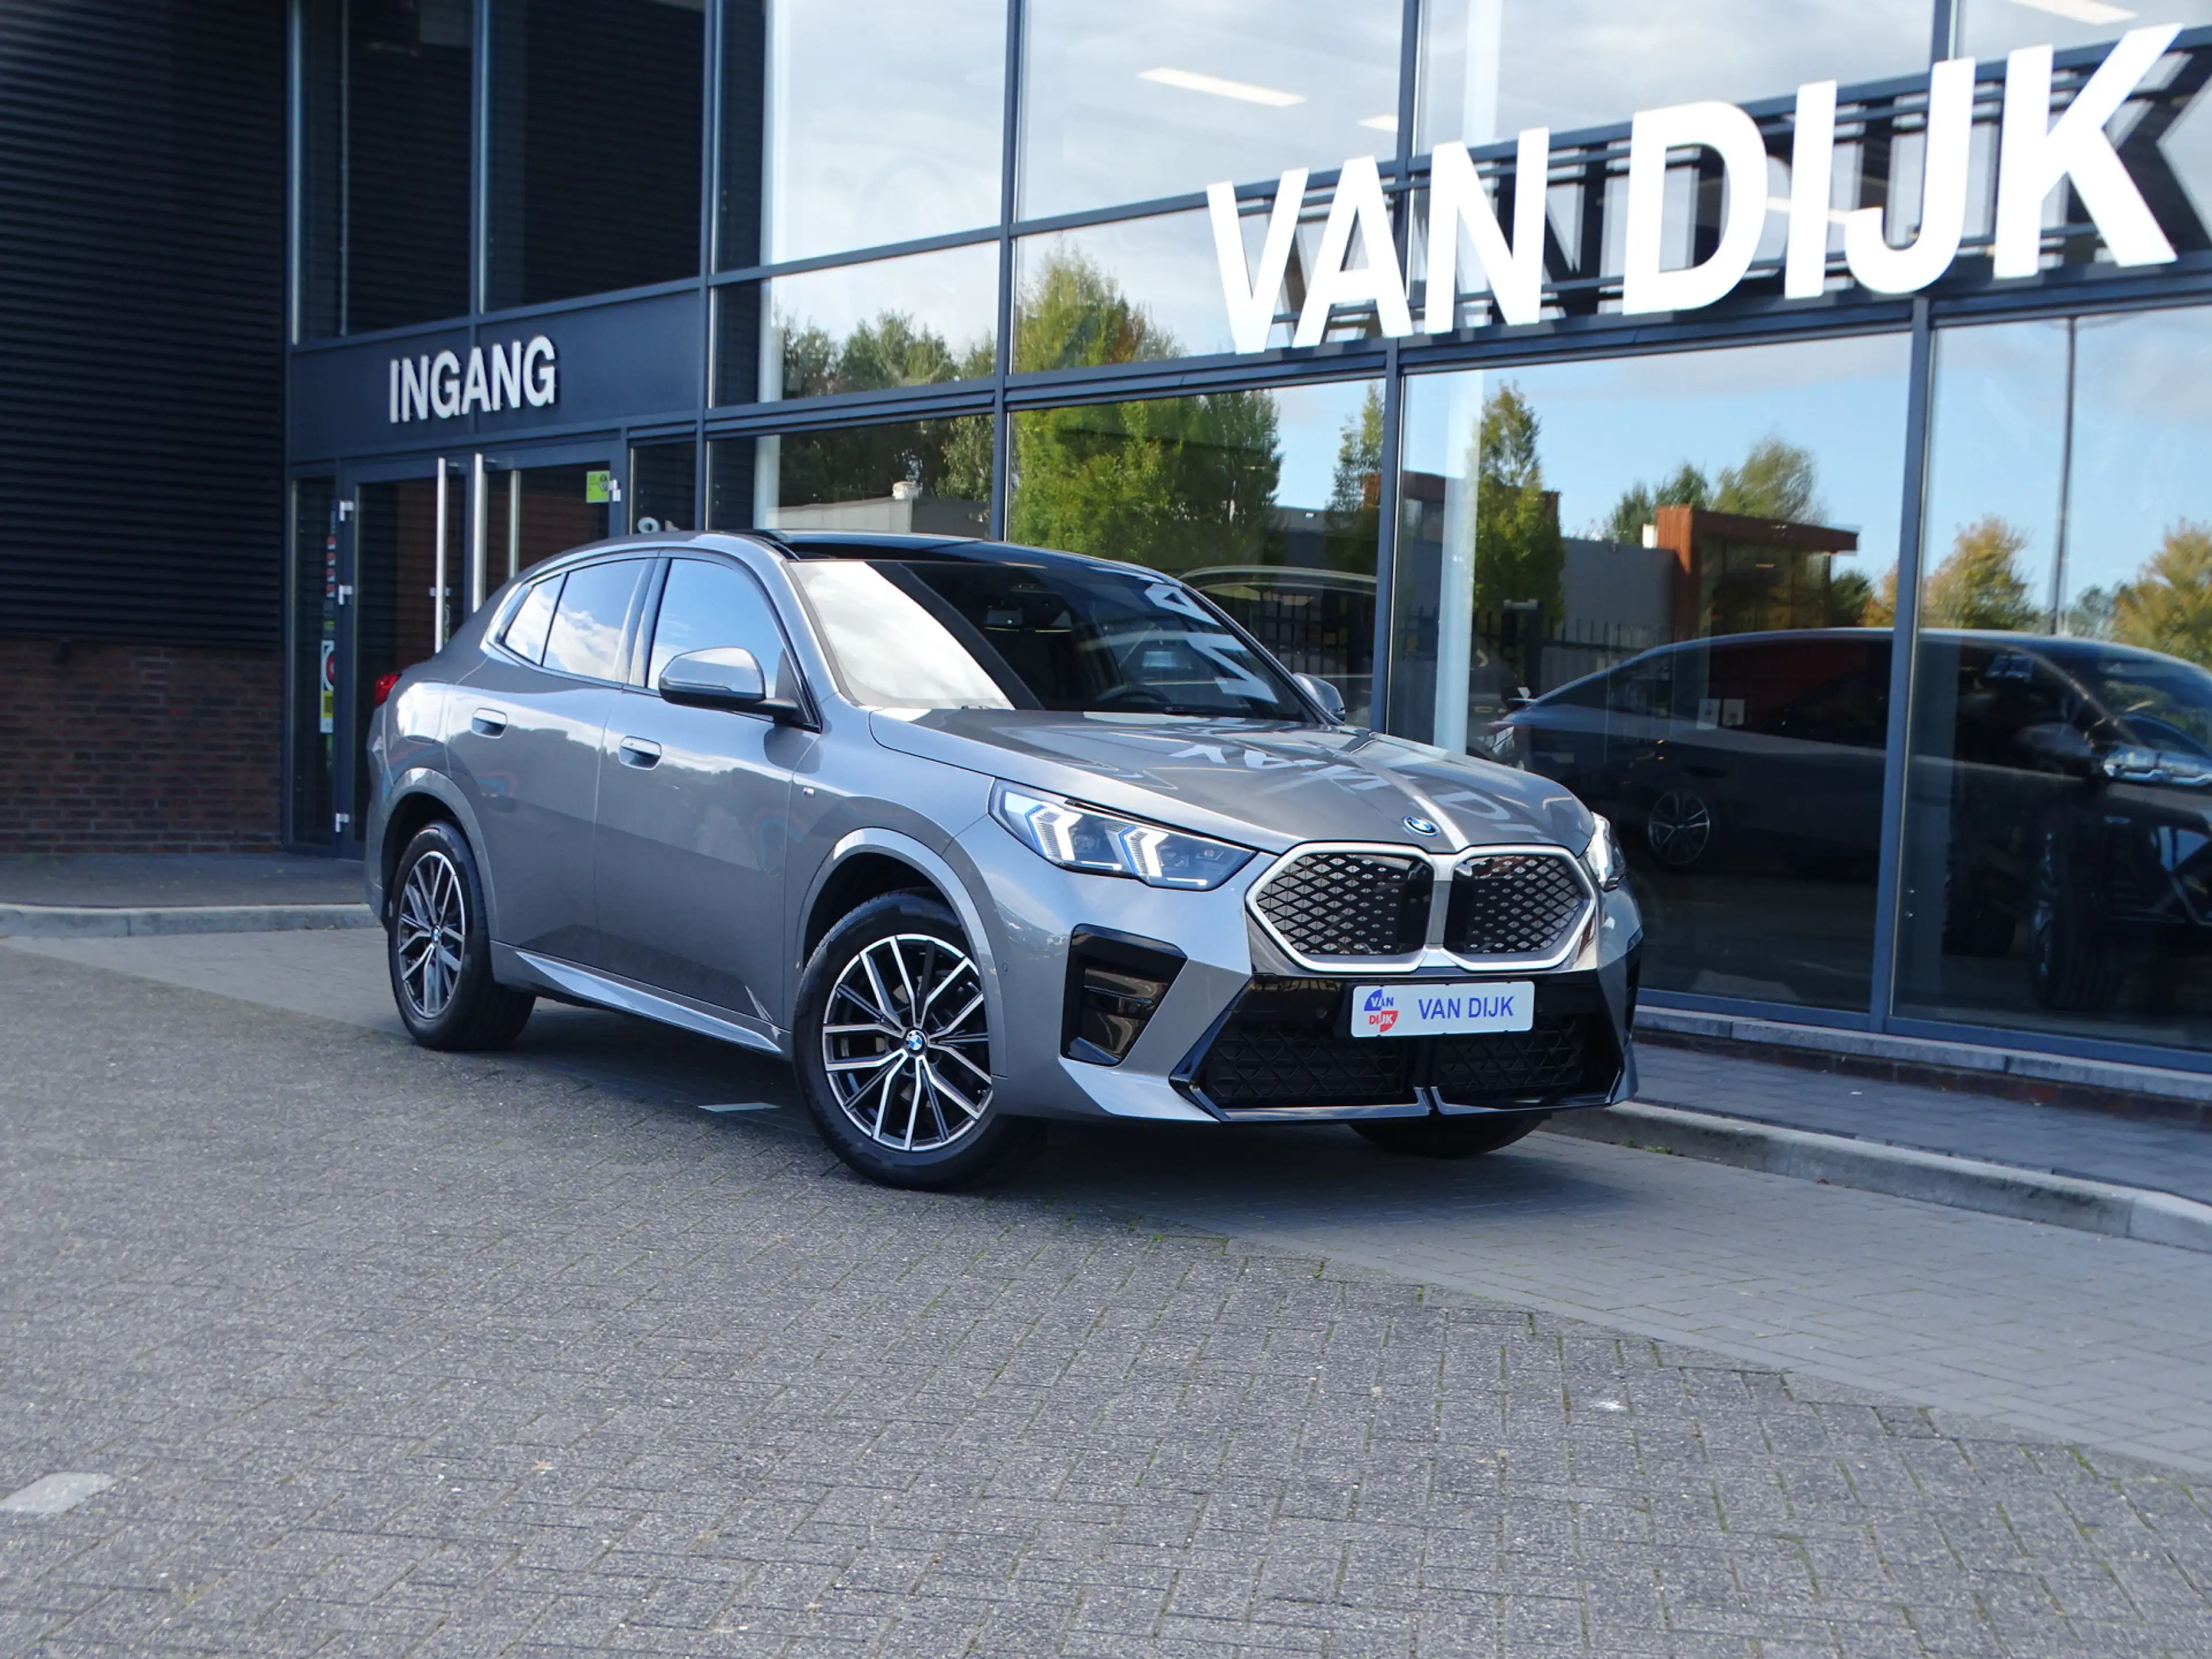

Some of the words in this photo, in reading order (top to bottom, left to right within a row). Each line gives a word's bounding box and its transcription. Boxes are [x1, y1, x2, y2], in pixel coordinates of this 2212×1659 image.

[1206, 126, 1550, 354] VAN
[1622, 23, 2185, 317] DIJK
[389, 335, 556, 424] INGANG
[1370, 997, 1394, 1007] VAN
[1418, 998, 1461, 1020] VAN
[1468, 995, 1514, 1018] DIJK
[1369, 1013, 1394, 1025] DIJK
